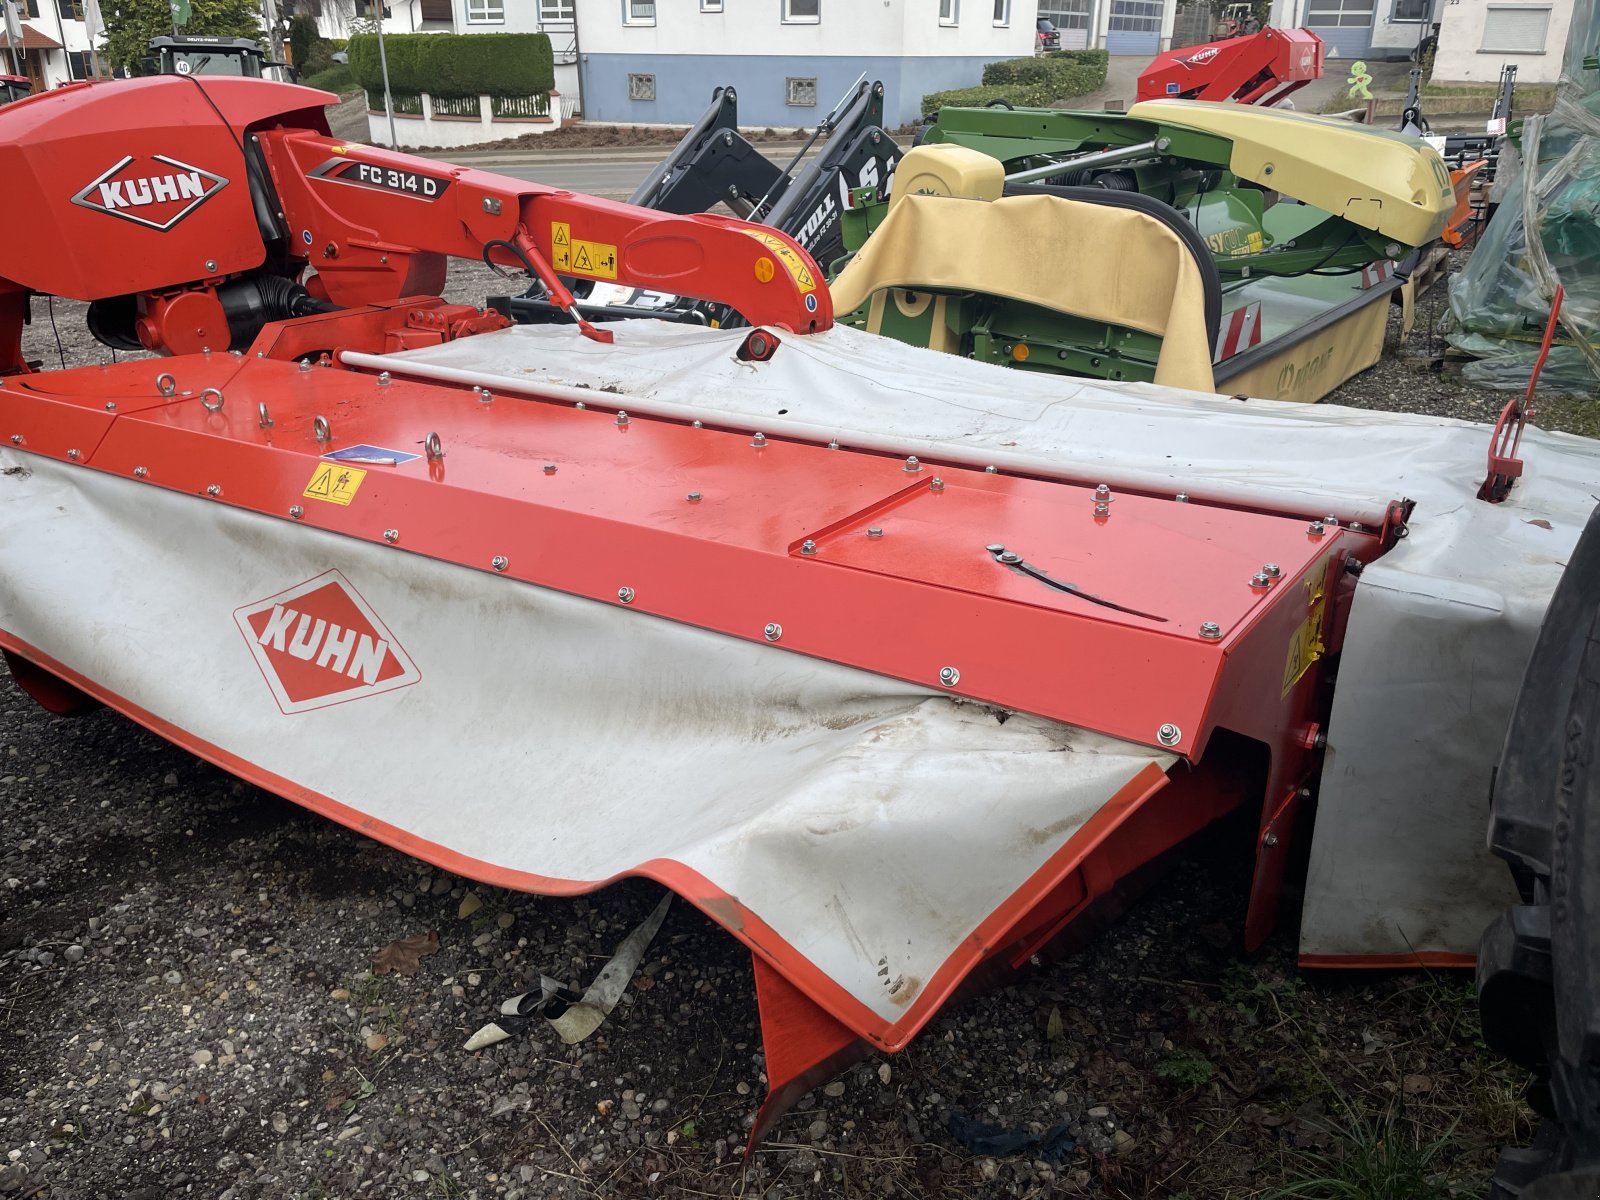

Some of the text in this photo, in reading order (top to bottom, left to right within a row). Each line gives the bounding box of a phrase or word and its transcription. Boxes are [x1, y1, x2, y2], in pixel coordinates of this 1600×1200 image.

[179, 63, 188, 72] 40
[1192, 48, 1218, 62] KUHN
[98, 172, 205, 209] KUHN
[359, 164, 437, 196] FC 314 D
[794, 193, 836, 247] TOLL
[257, 602, 390, 687] KUHN
